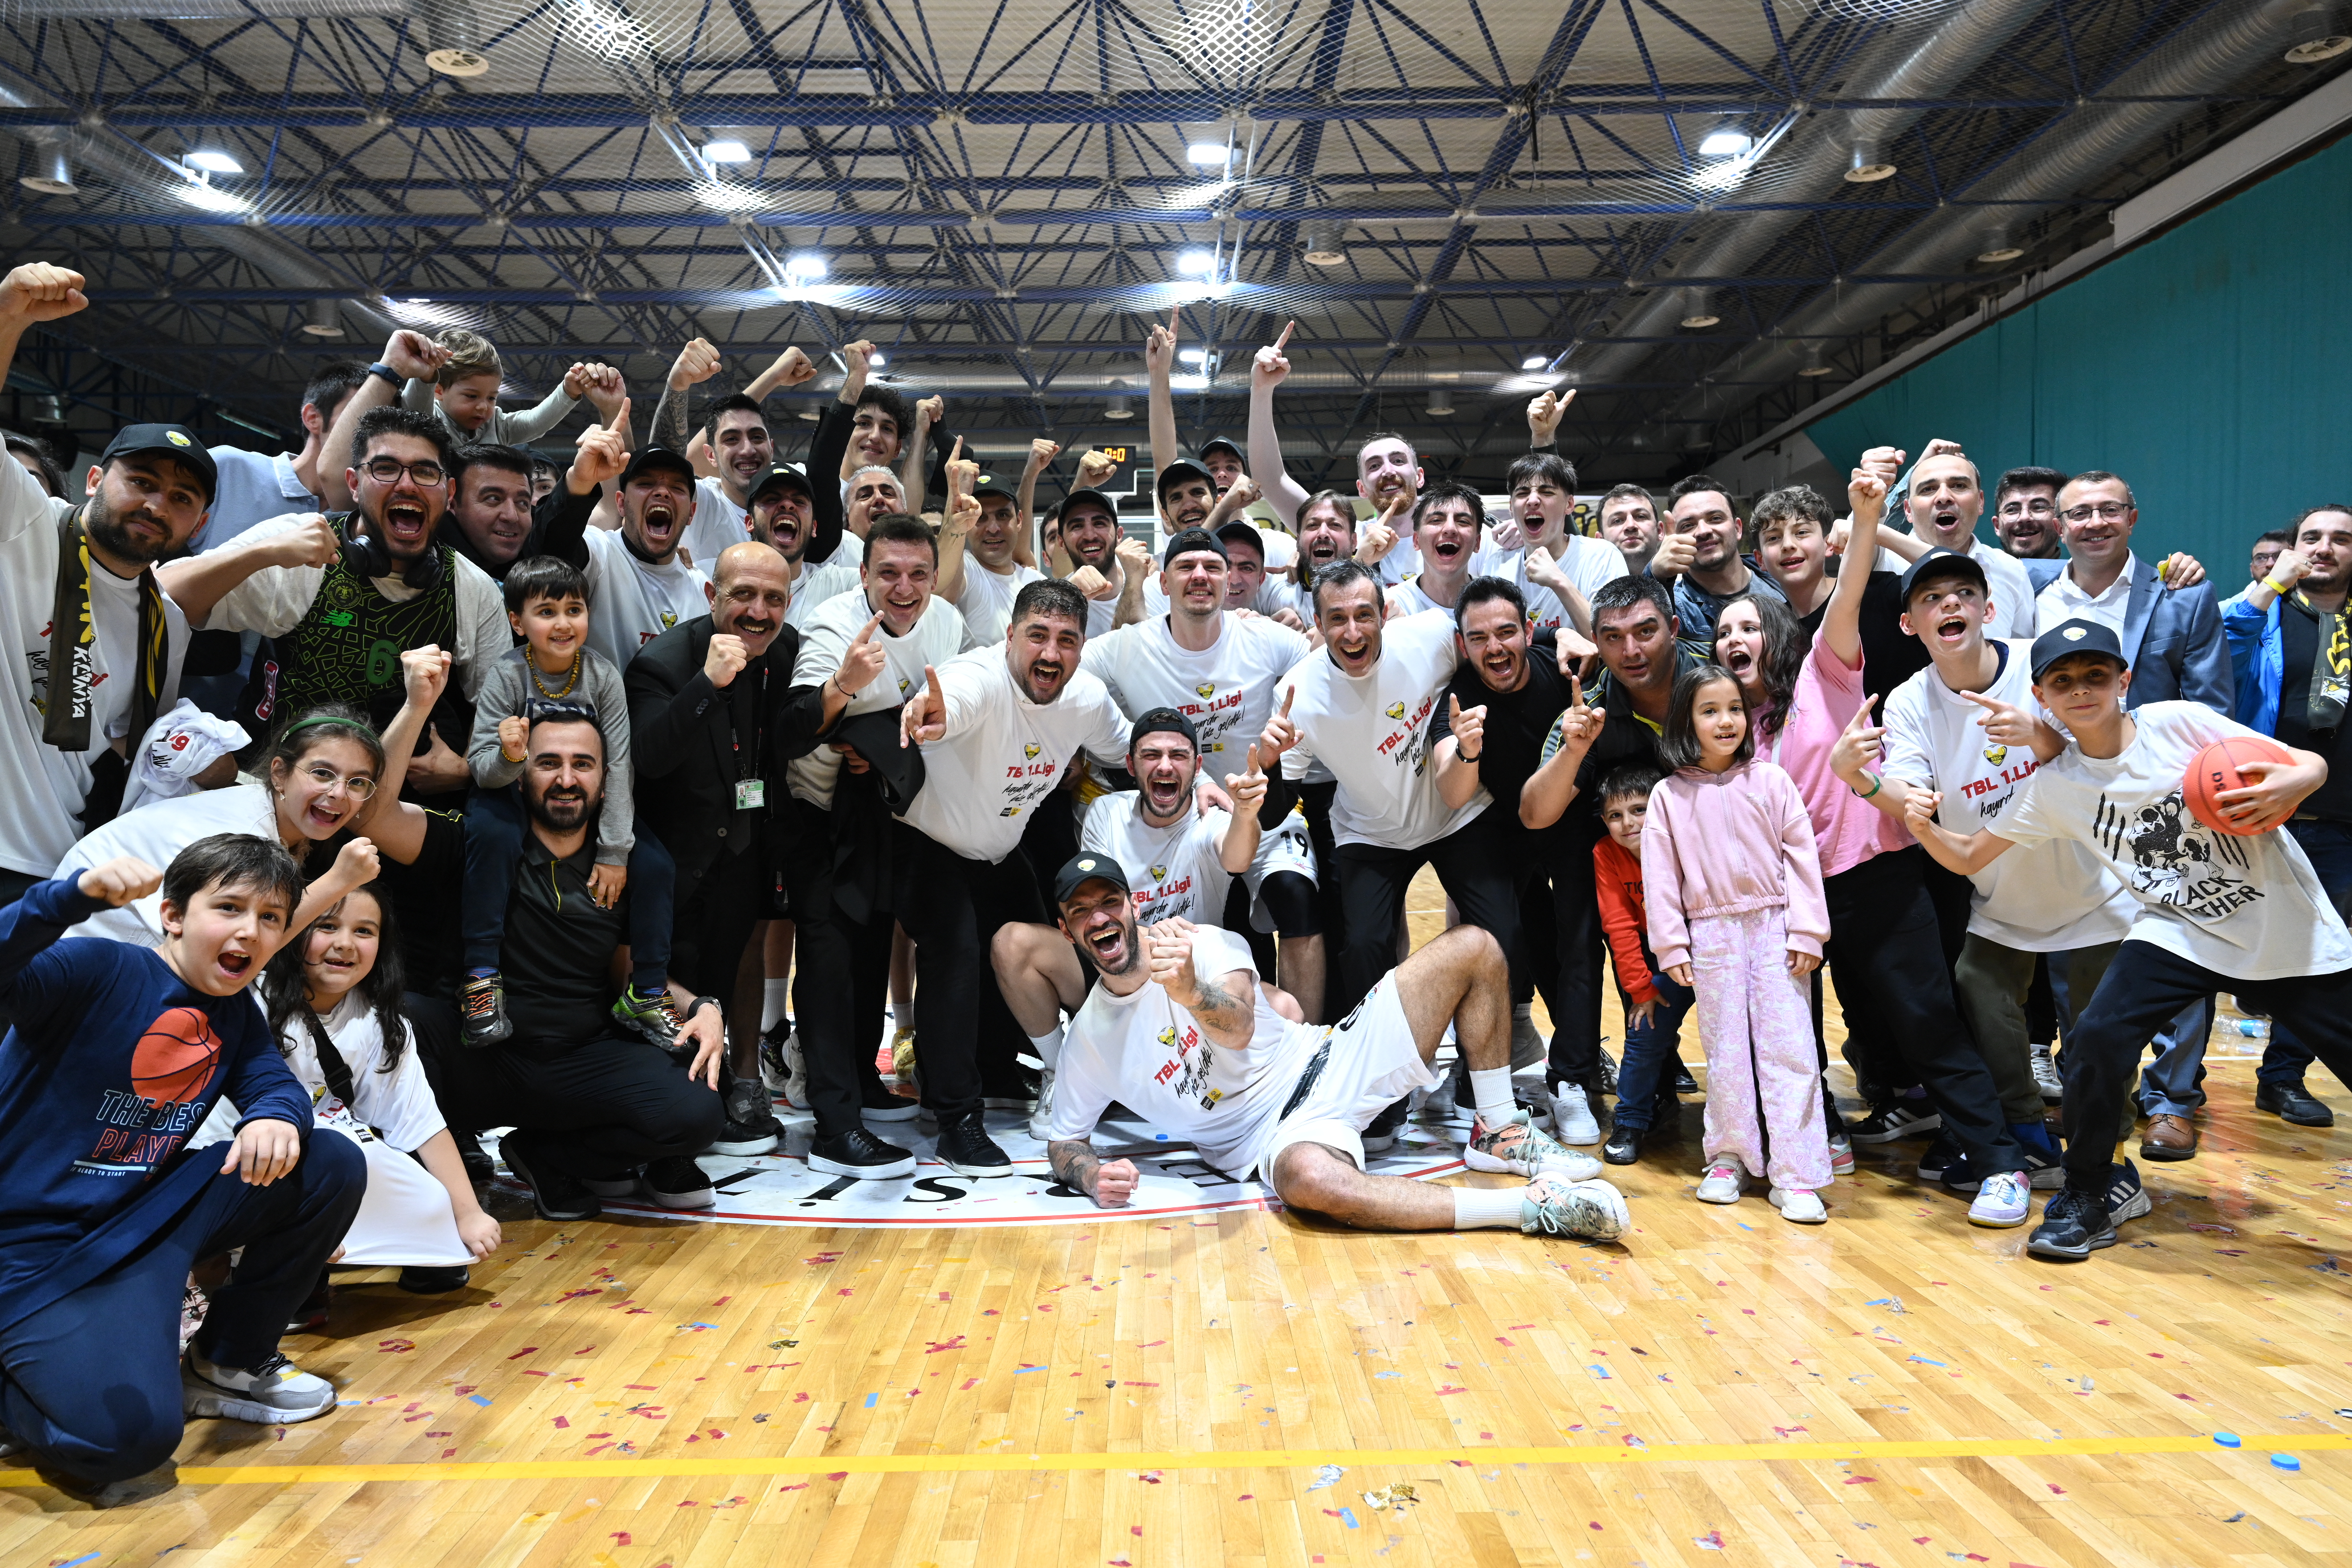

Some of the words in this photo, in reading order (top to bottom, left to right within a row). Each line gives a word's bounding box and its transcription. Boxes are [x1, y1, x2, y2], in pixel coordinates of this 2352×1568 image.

[330, 579, 360, 594] KONYASPOR
[366, 639, 399, 685] 6
[1177, 704, 1204, 716] TBL
[1208, 689, 1242, 712] 1.Ligi
[1193, 713, 1220, 733] ayırdır
[1202, 726, 1214, 741] biz
[1377, 731, 1405, 756] TBL
[1403, 696, 1432, 732] 1.Ligi
[1411, 747, 1422, 765] biz
[1006, 766, 1023, 778] TB
[1028, 759, 1055, 777] 1.Ligi
[1961, 777, 1999, 799] TBL
[1280, 830, 1308, 858] 19
[1157, 875, 1191, 898] 1.Ligi
[1154, 1059, 1181, 1086] TBL
[96, 1089, 156, 1128] THE
[77, 1167, 96, 1175] READY
